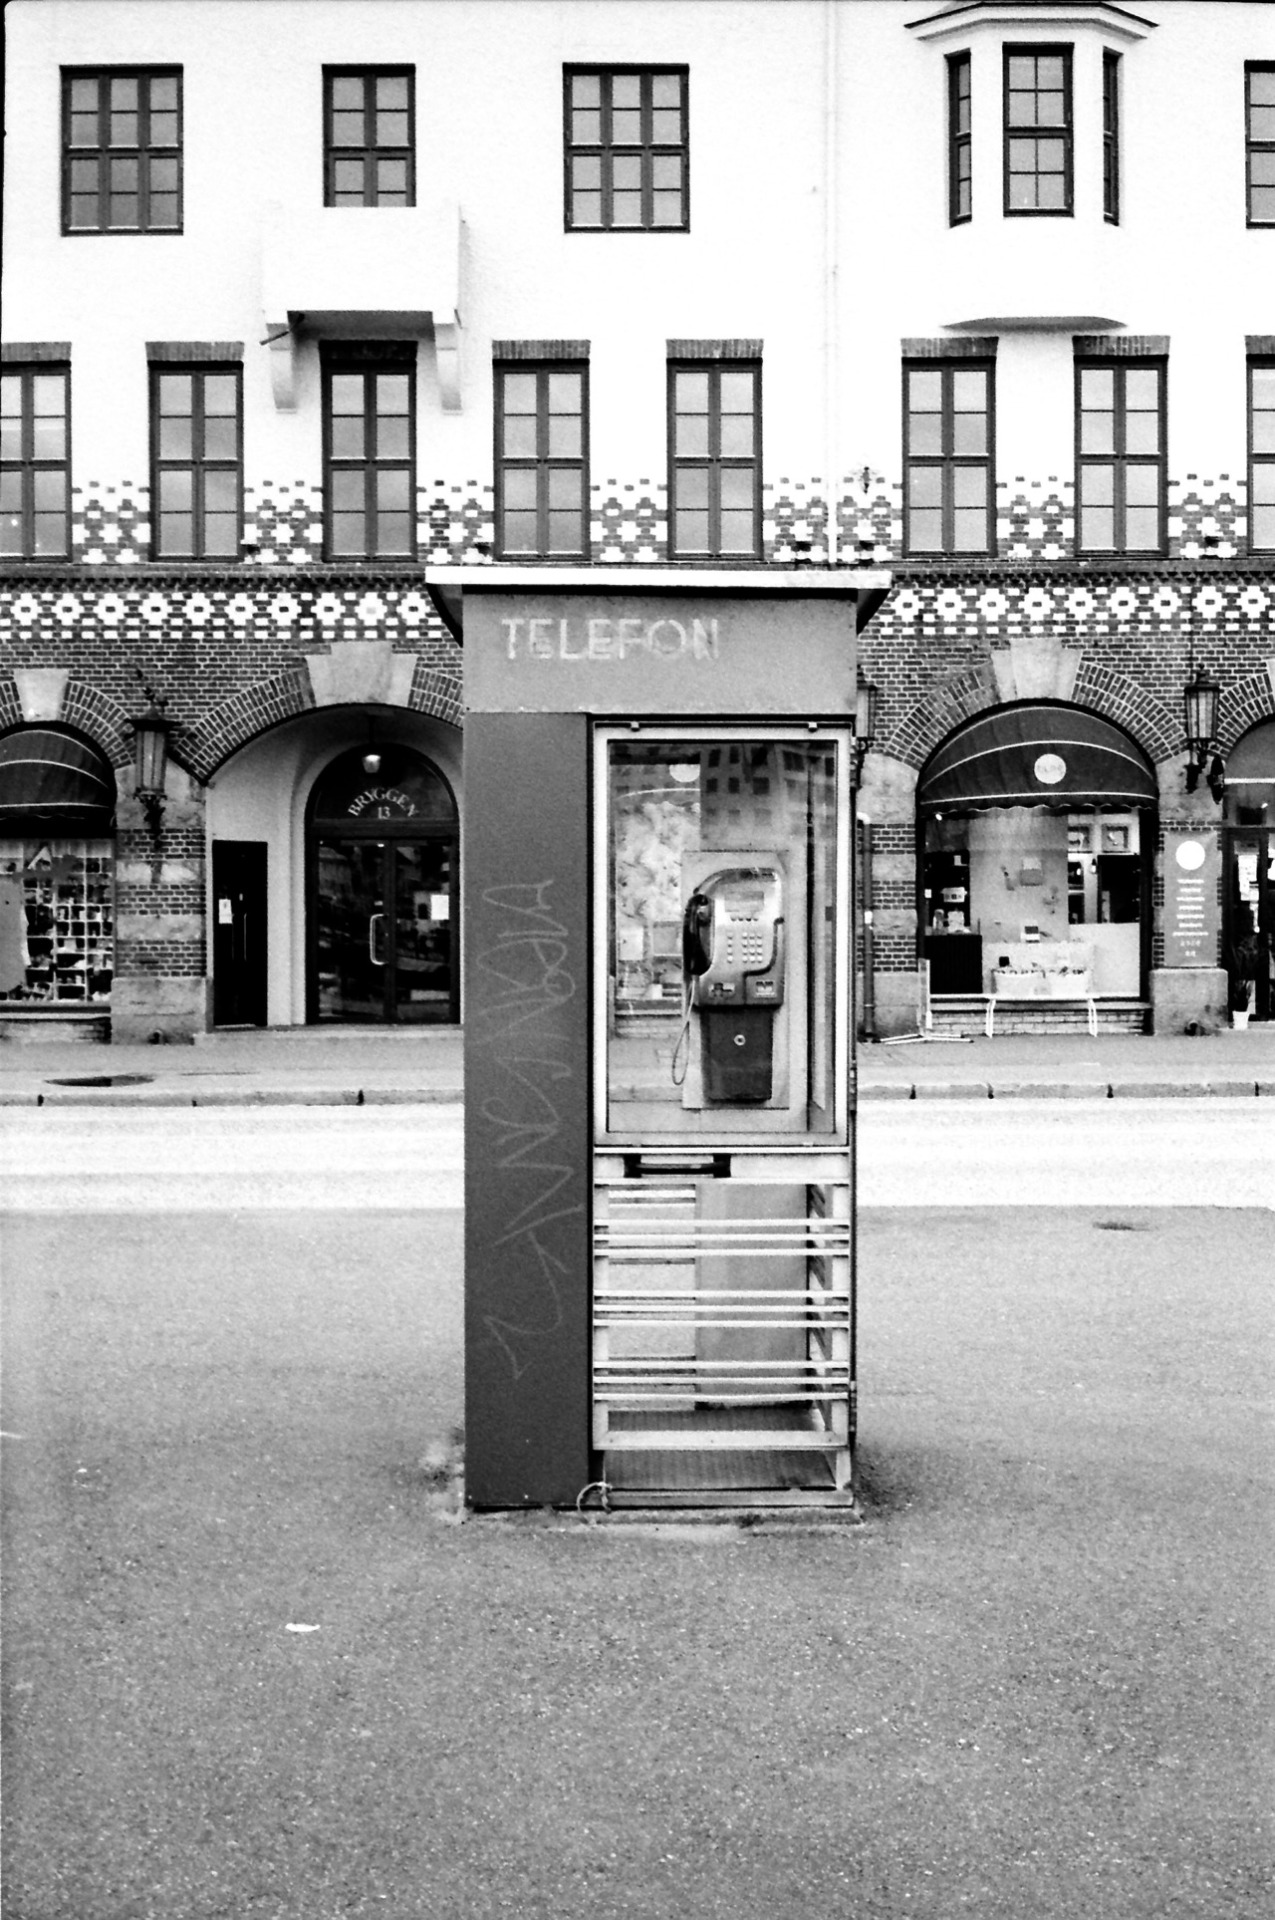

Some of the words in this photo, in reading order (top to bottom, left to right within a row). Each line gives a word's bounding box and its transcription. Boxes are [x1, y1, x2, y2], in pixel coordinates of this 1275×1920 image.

[502, 618, 718, 660] TELEFON
[348, 787, 419, 817] BRYGGEN
[378, 806, 391, 820] 13
